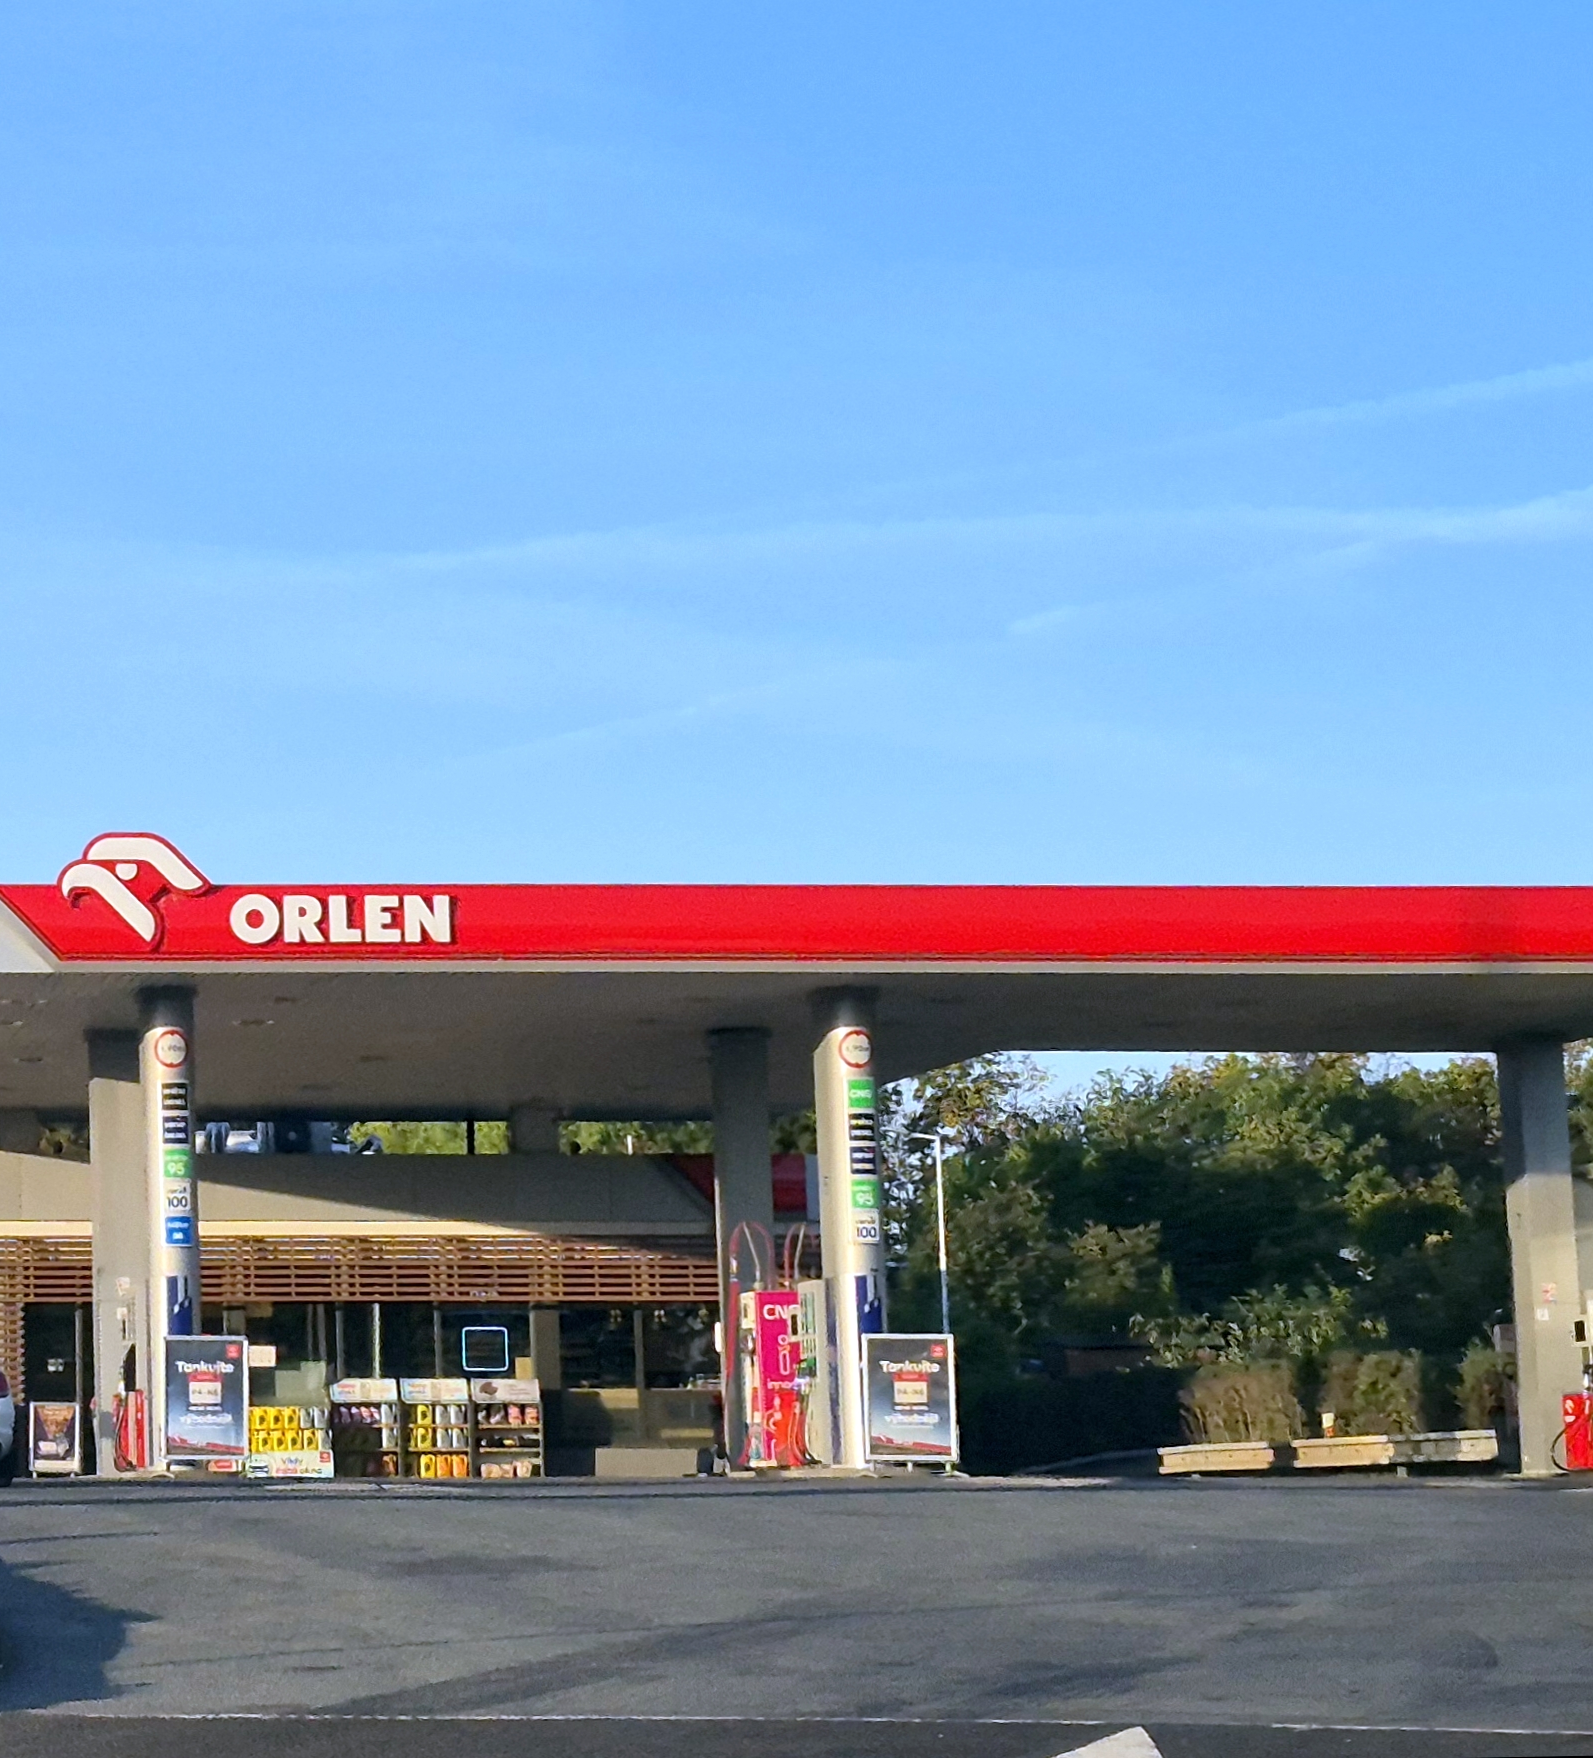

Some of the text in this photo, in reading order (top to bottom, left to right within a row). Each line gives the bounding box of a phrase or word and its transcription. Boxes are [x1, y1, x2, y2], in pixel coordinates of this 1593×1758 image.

[229, 893, 452, 945] ORLEN
[167, 1195, 188, 1208] 100
[856, 1226, 877, 1238] 100
[763, 1304, 800, 1320] CN
